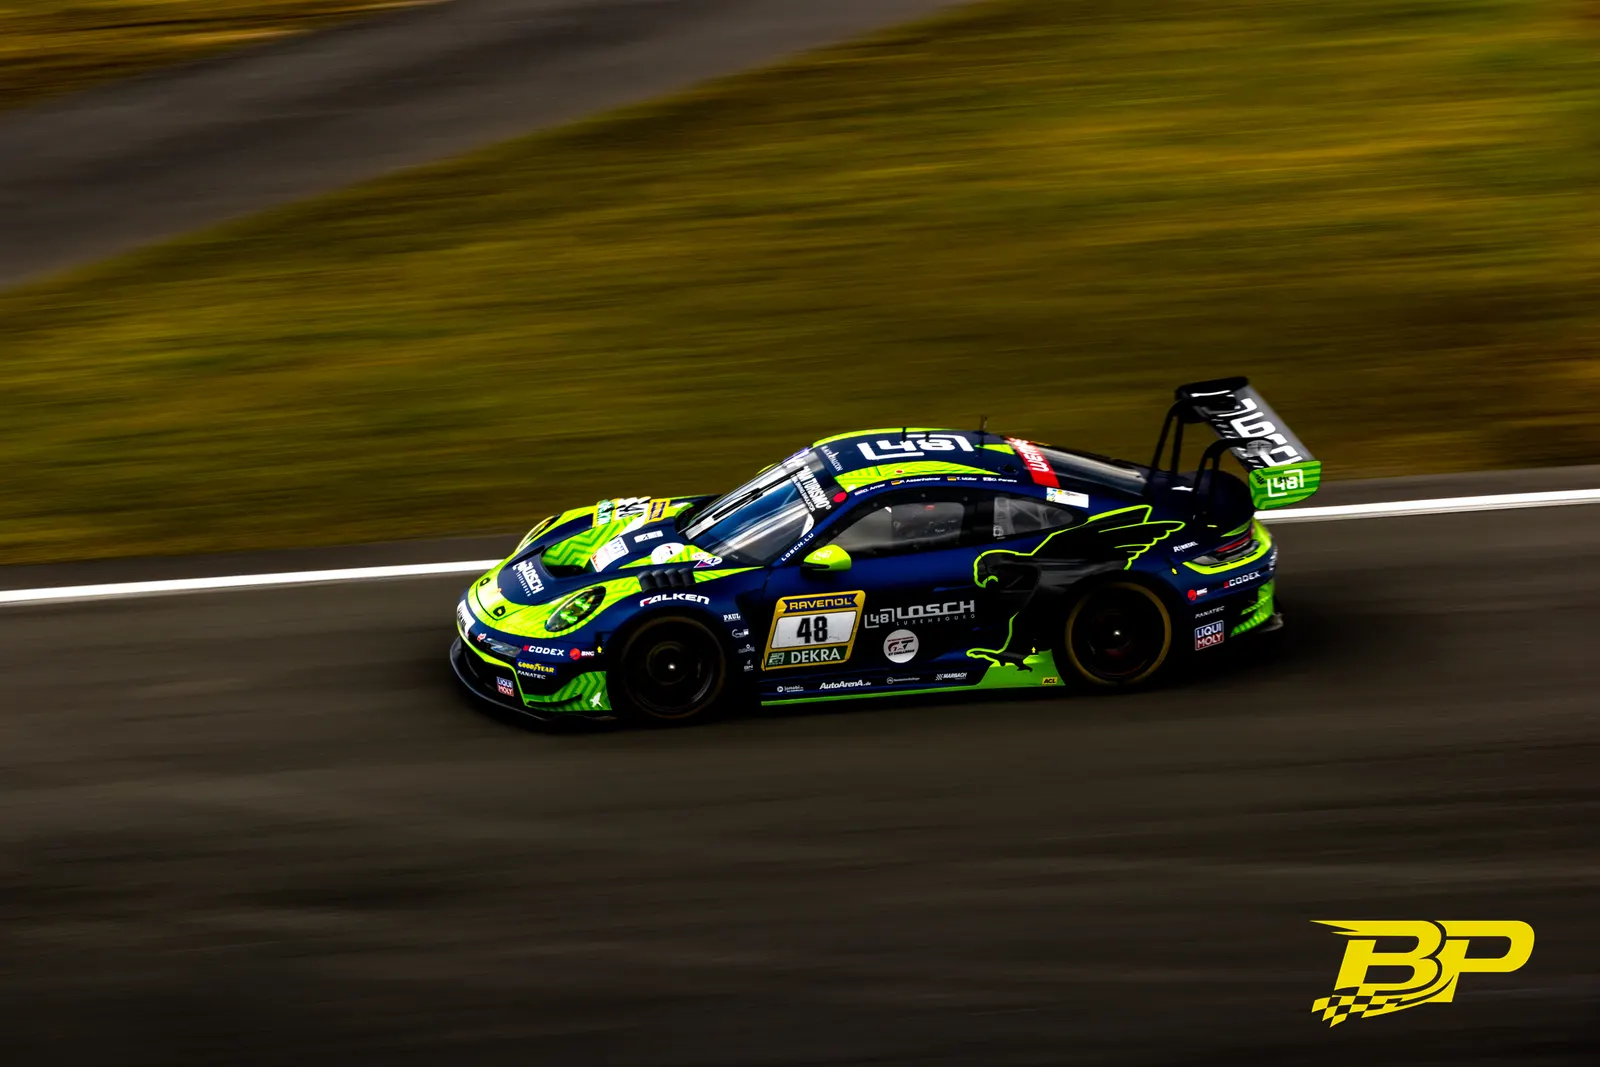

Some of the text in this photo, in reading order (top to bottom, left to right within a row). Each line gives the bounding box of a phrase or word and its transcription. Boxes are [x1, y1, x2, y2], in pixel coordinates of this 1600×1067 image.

[781, 532, 815, 562] LOSCH.LU
[1228, 571, 1261, 587] CODEX
[639, 593, 710, 607] FALKEN
[789, 597, 852, 611] RAVENOL
[896, 600, 975, 619] LOSCH
[896, 614, 975, 627] LUXEMBOURG
[797, 616, 828, 644] 48
[1196, 622, 1223, 639] LIQUI
[1196, 632, 1222, 649] MOLY
[528, 645, 565, 657] CODEX
[790, 647, 841, 664] DEKRA
[517, 661, 555, 674] GOODYEAR
[517, 669, 547, 680] FANATEC
[497, 684, 514, 696] MOLY
